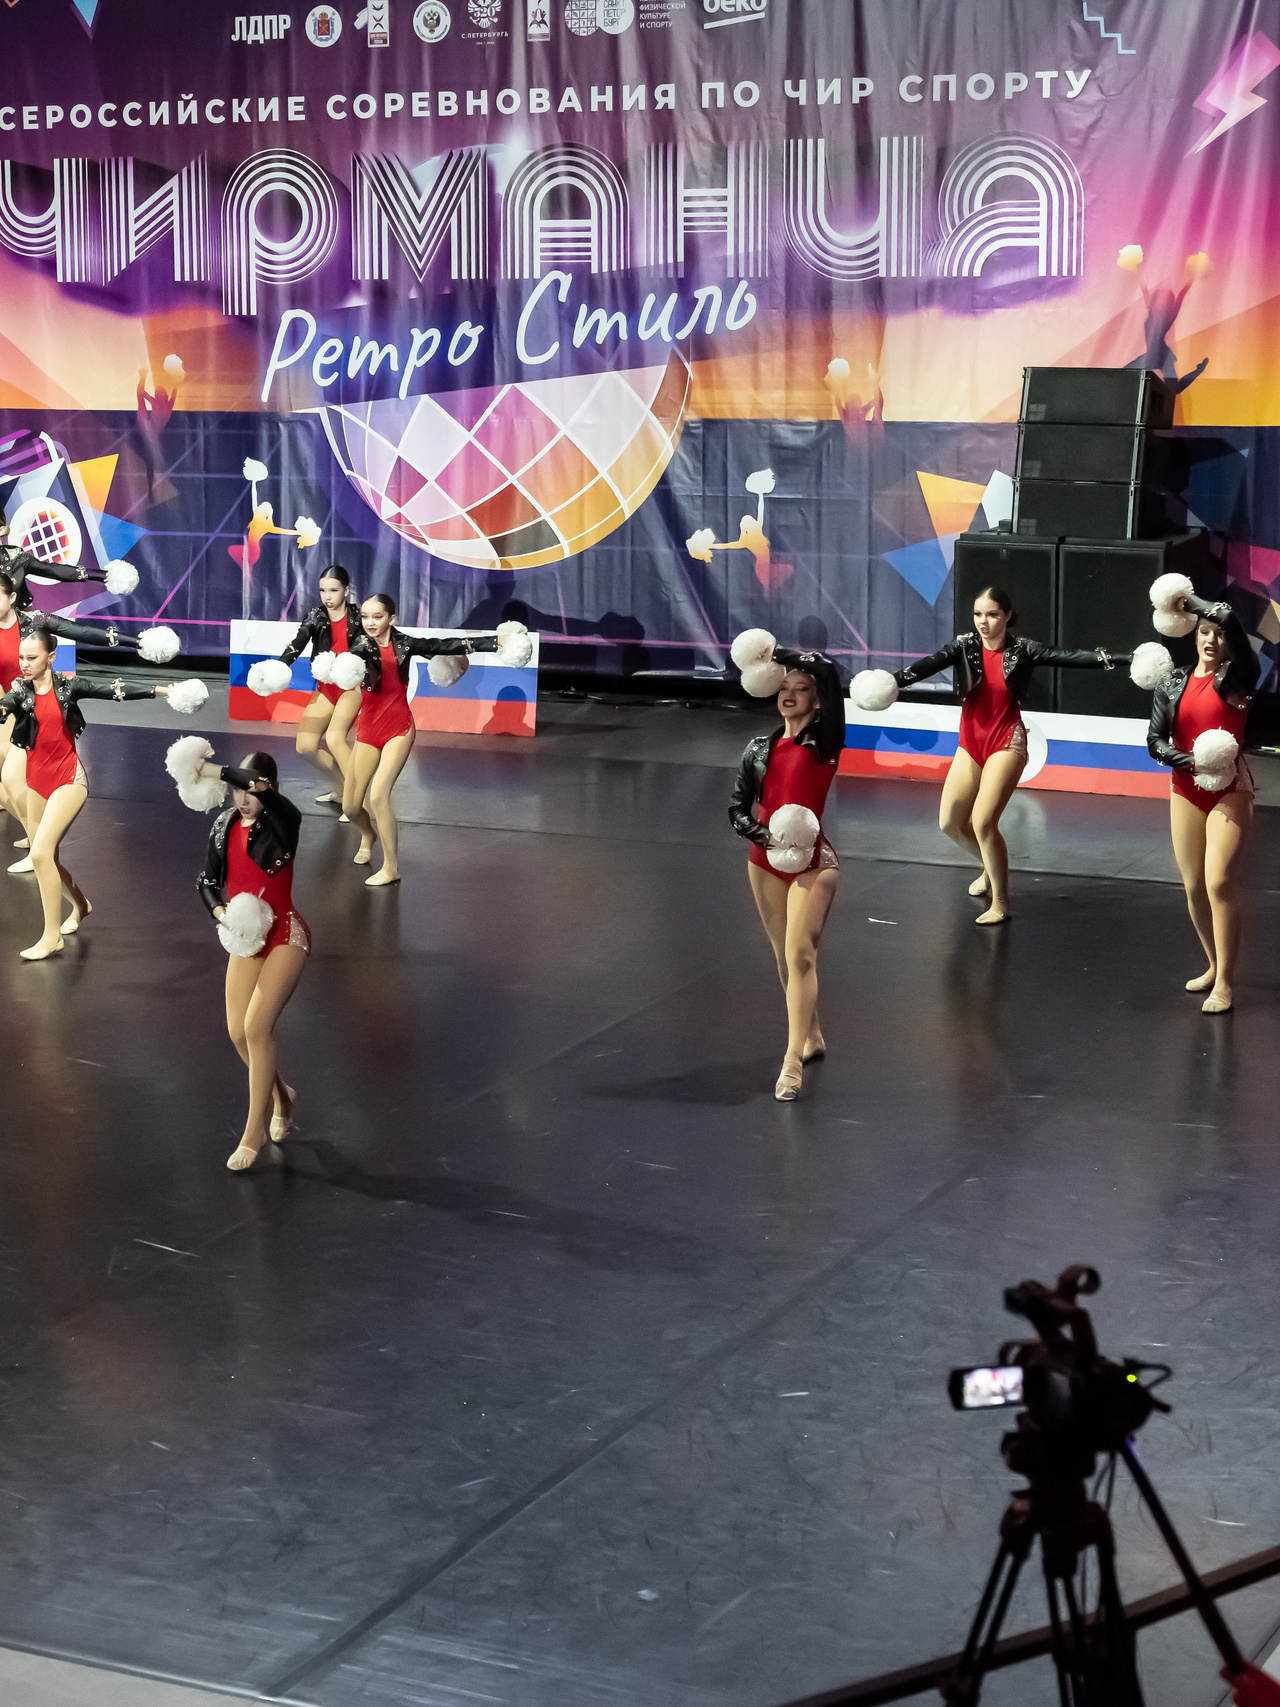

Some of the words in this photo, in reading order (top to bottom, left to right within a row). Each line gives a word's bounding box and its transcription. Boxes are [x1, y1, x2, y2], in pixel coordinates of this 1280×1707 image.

[639, 1, 686, 11] ФИЗИЧЕСКОЙ
[639, 12, 672, 20] КУЛЬТУРЕ
[231, 14, 292, 44] ЛДПР
[646, 21, 673, 29] СПОРТУ
[326, 83, 676, 120] СОРЕВНОВАНИЯ
[701, 80, 761, 108] ПО
[783, 77, 875, 105] ЧИР
[898, 69, 1093, 102] СПОРТУ
[261, 308, 485, 404] Ретро
[516, 270, 758, 366] Стиль
